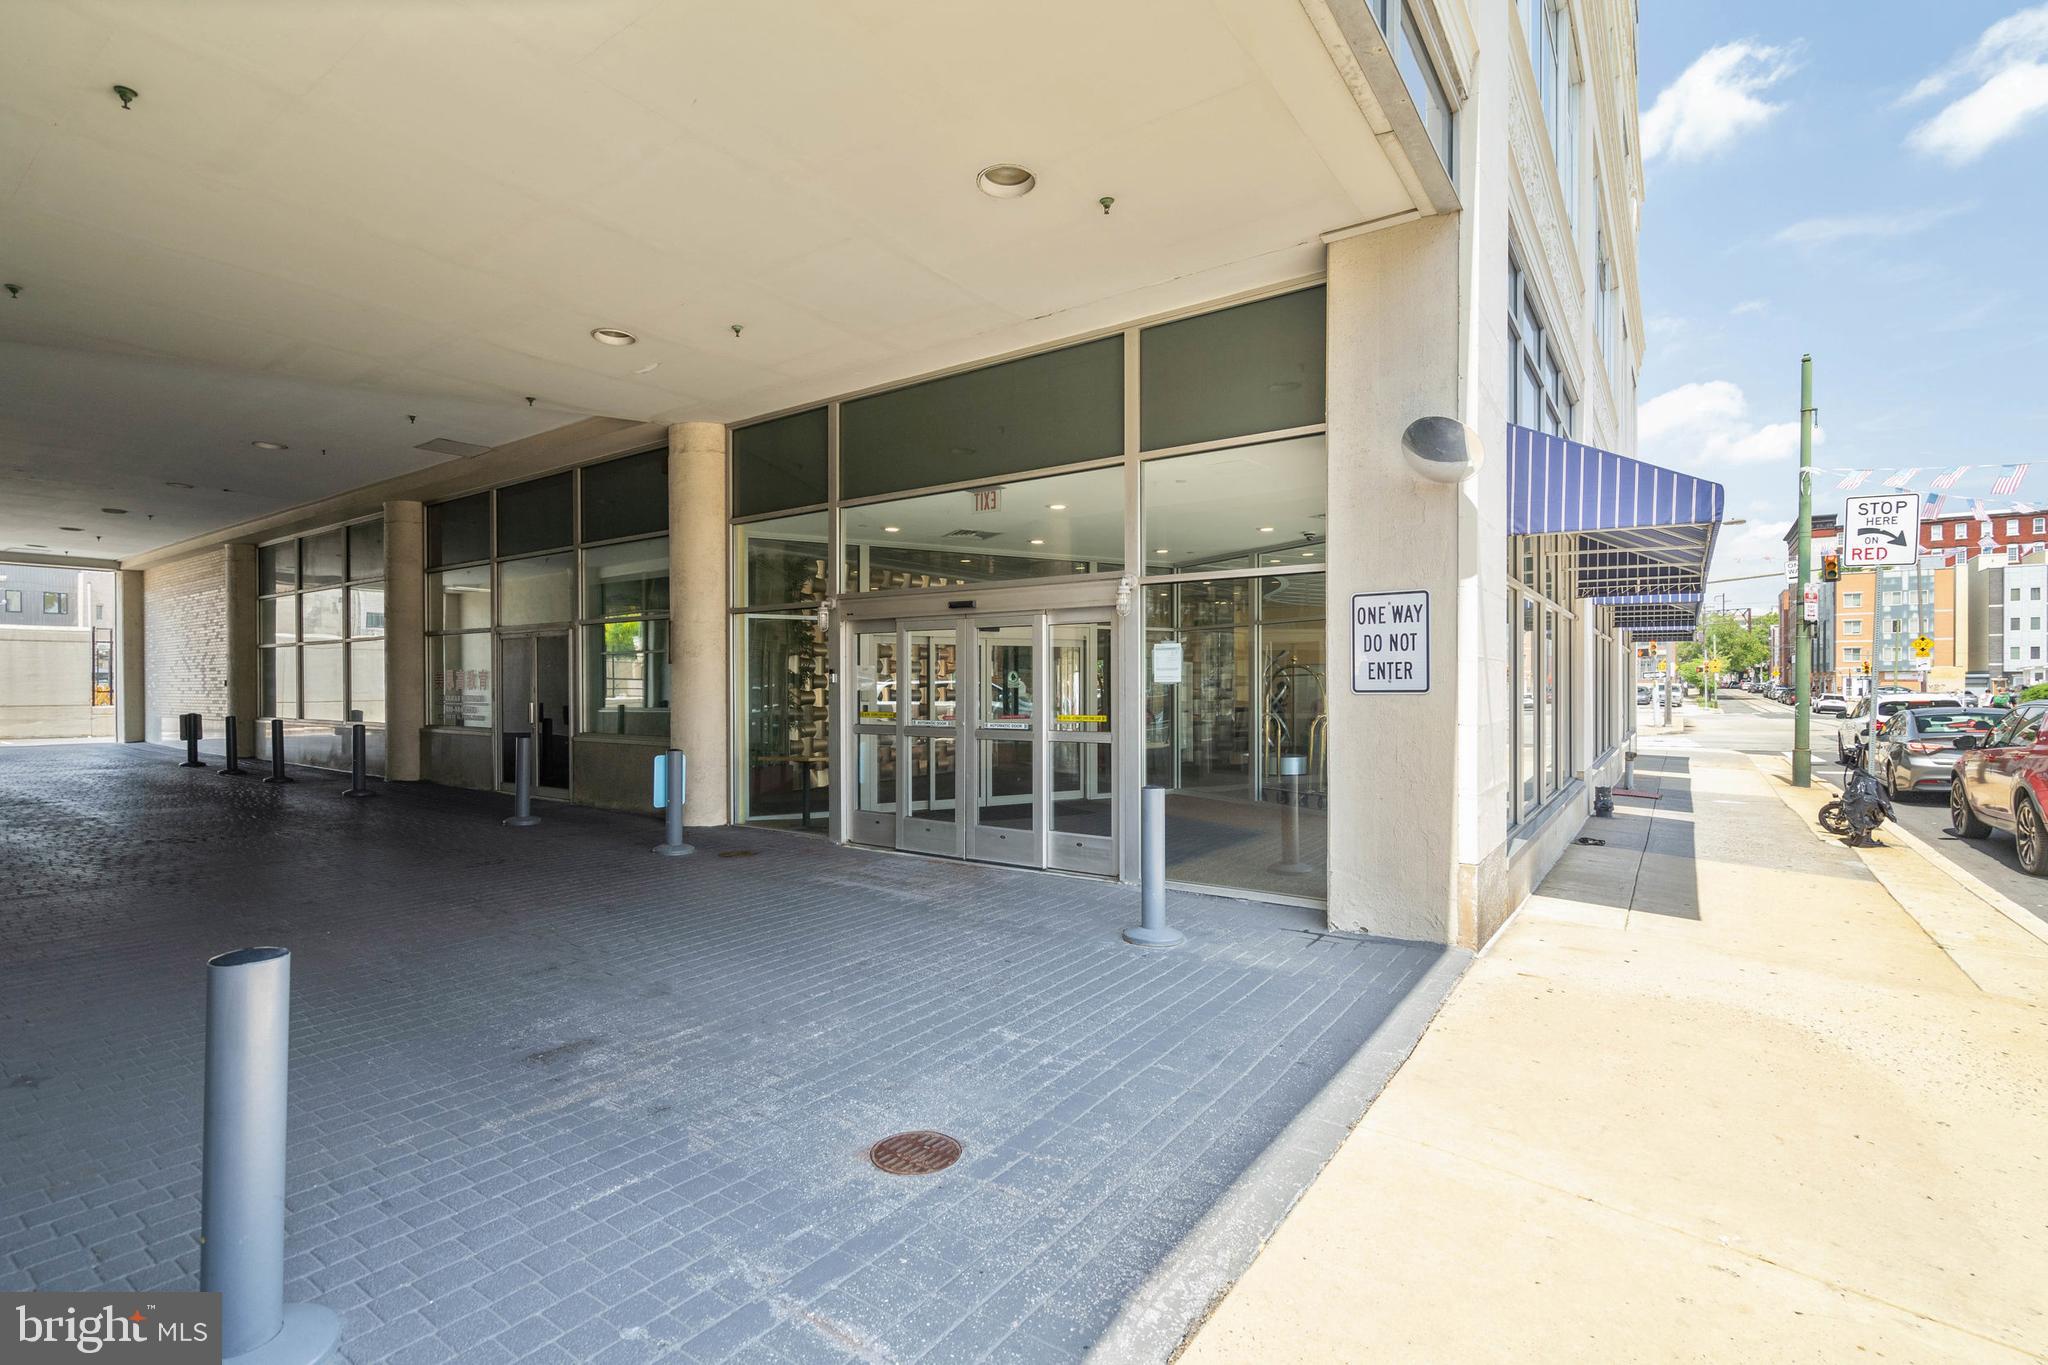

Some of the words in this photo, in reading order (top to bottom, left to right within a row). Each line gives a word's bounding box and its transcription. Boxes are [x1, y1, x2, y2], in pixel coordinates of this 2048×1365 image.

[1858, 500, 1908, 516] STOP
[1866, 516, 1898, 526] HERE
[1864, 536, 1879, 545] ON
[1851, 547, 1888, 561] RED
[1357, 606, 1386, 625] ONE
[1392, 603, 1423, 623] WAY
[1363, 634, 1382, 652] DO
[1389, 633, 1418, 651] NOT
[1368, 661, 1413, 680] ENTER
